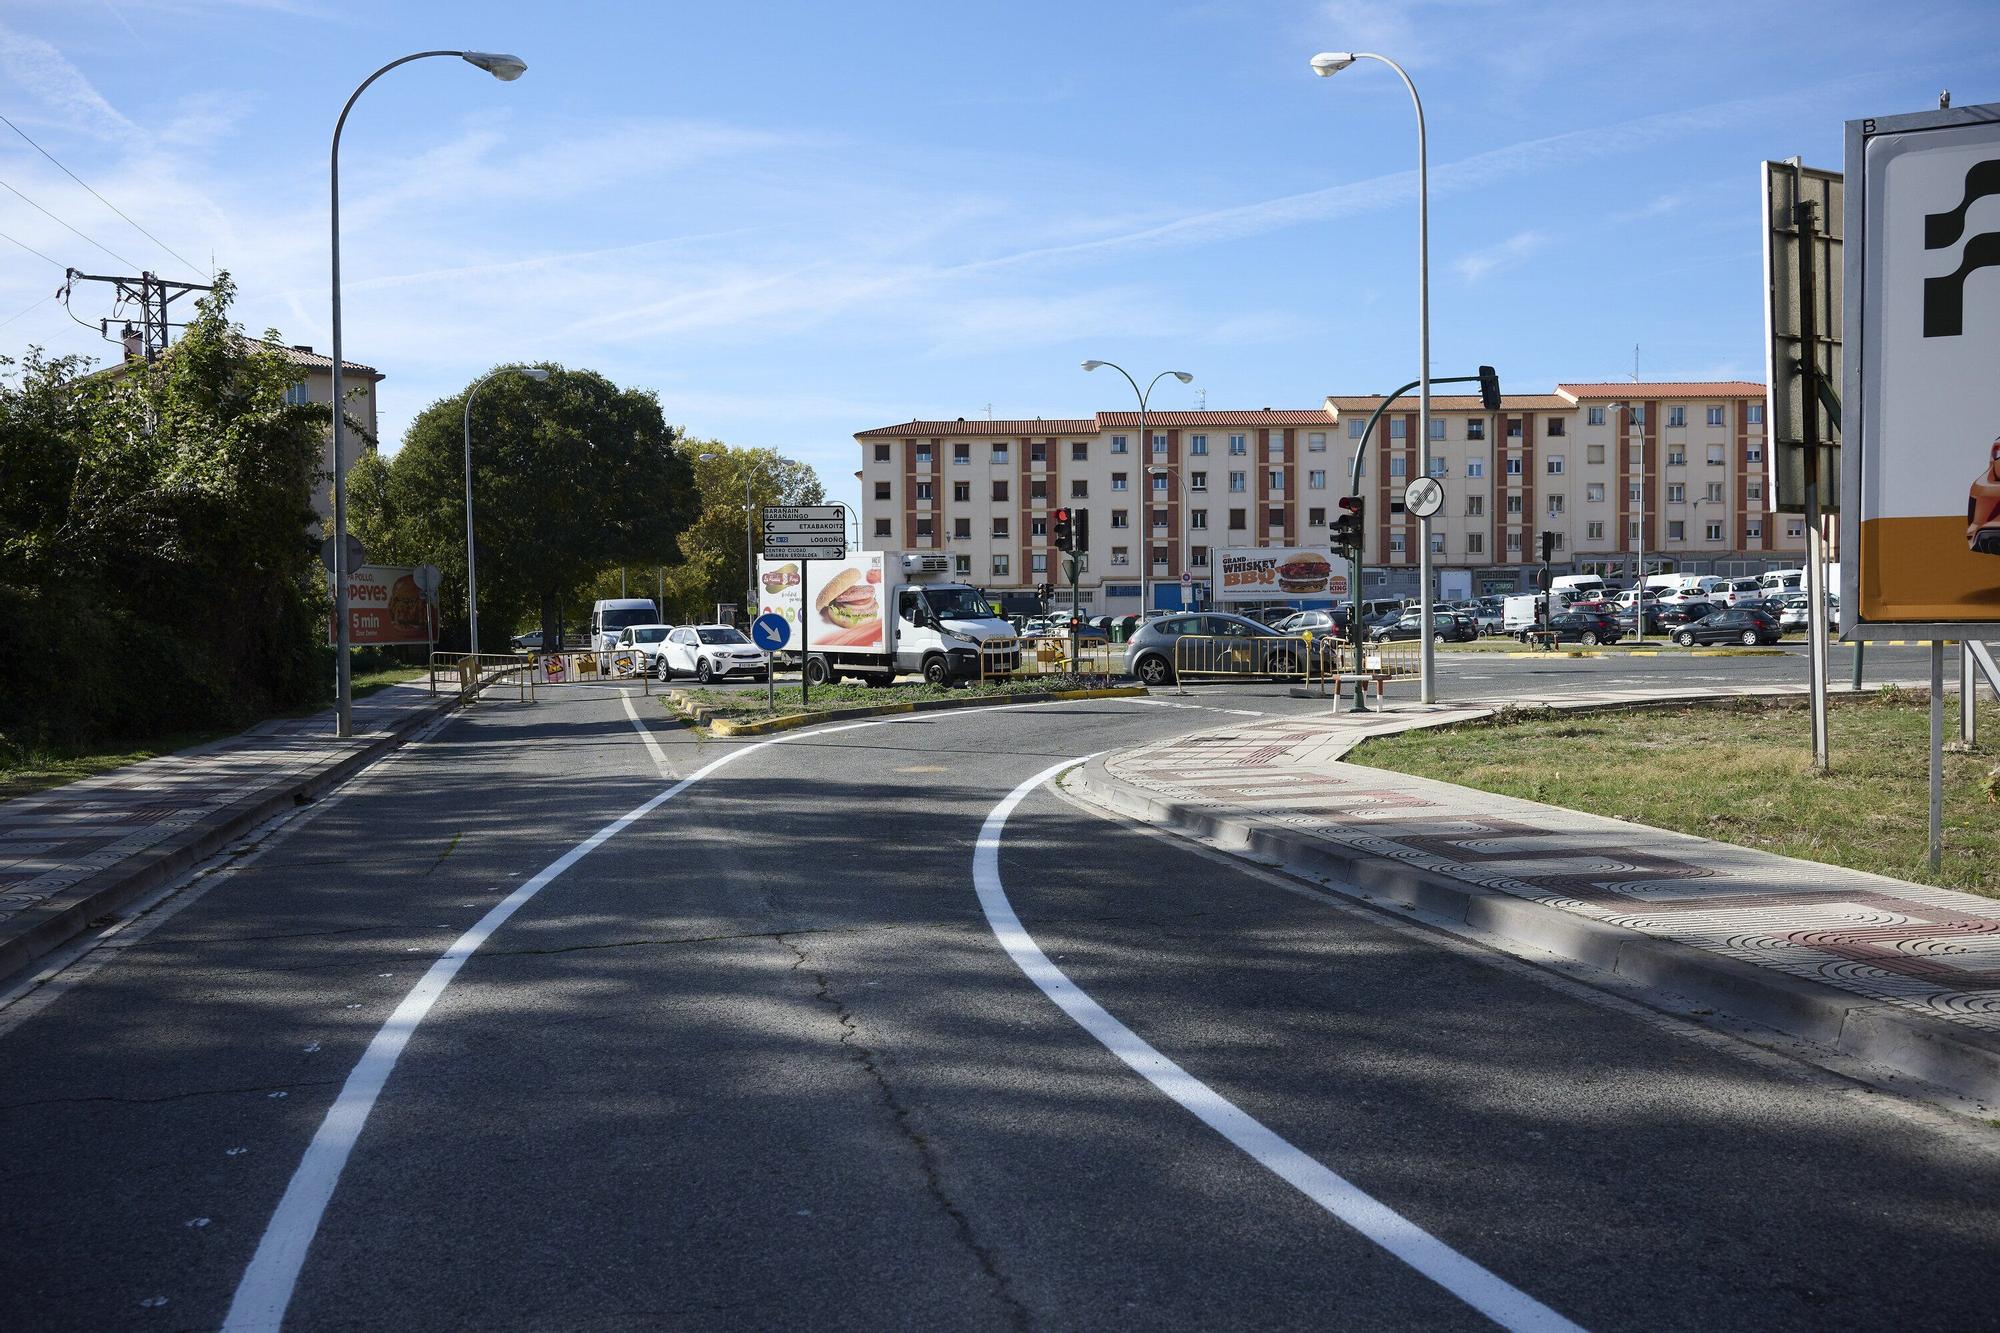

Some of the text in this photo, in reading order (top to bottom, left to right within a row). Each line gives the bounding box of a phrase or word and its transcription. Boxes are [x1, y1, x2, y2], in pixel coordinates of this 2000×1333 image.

[1863, 119, 1876, 133] B
[1223, 559, 1277, 573] WHISKEY
[1223, 569, 1275, 586] BBQ
[352, 613, 380, 628] 5 min
